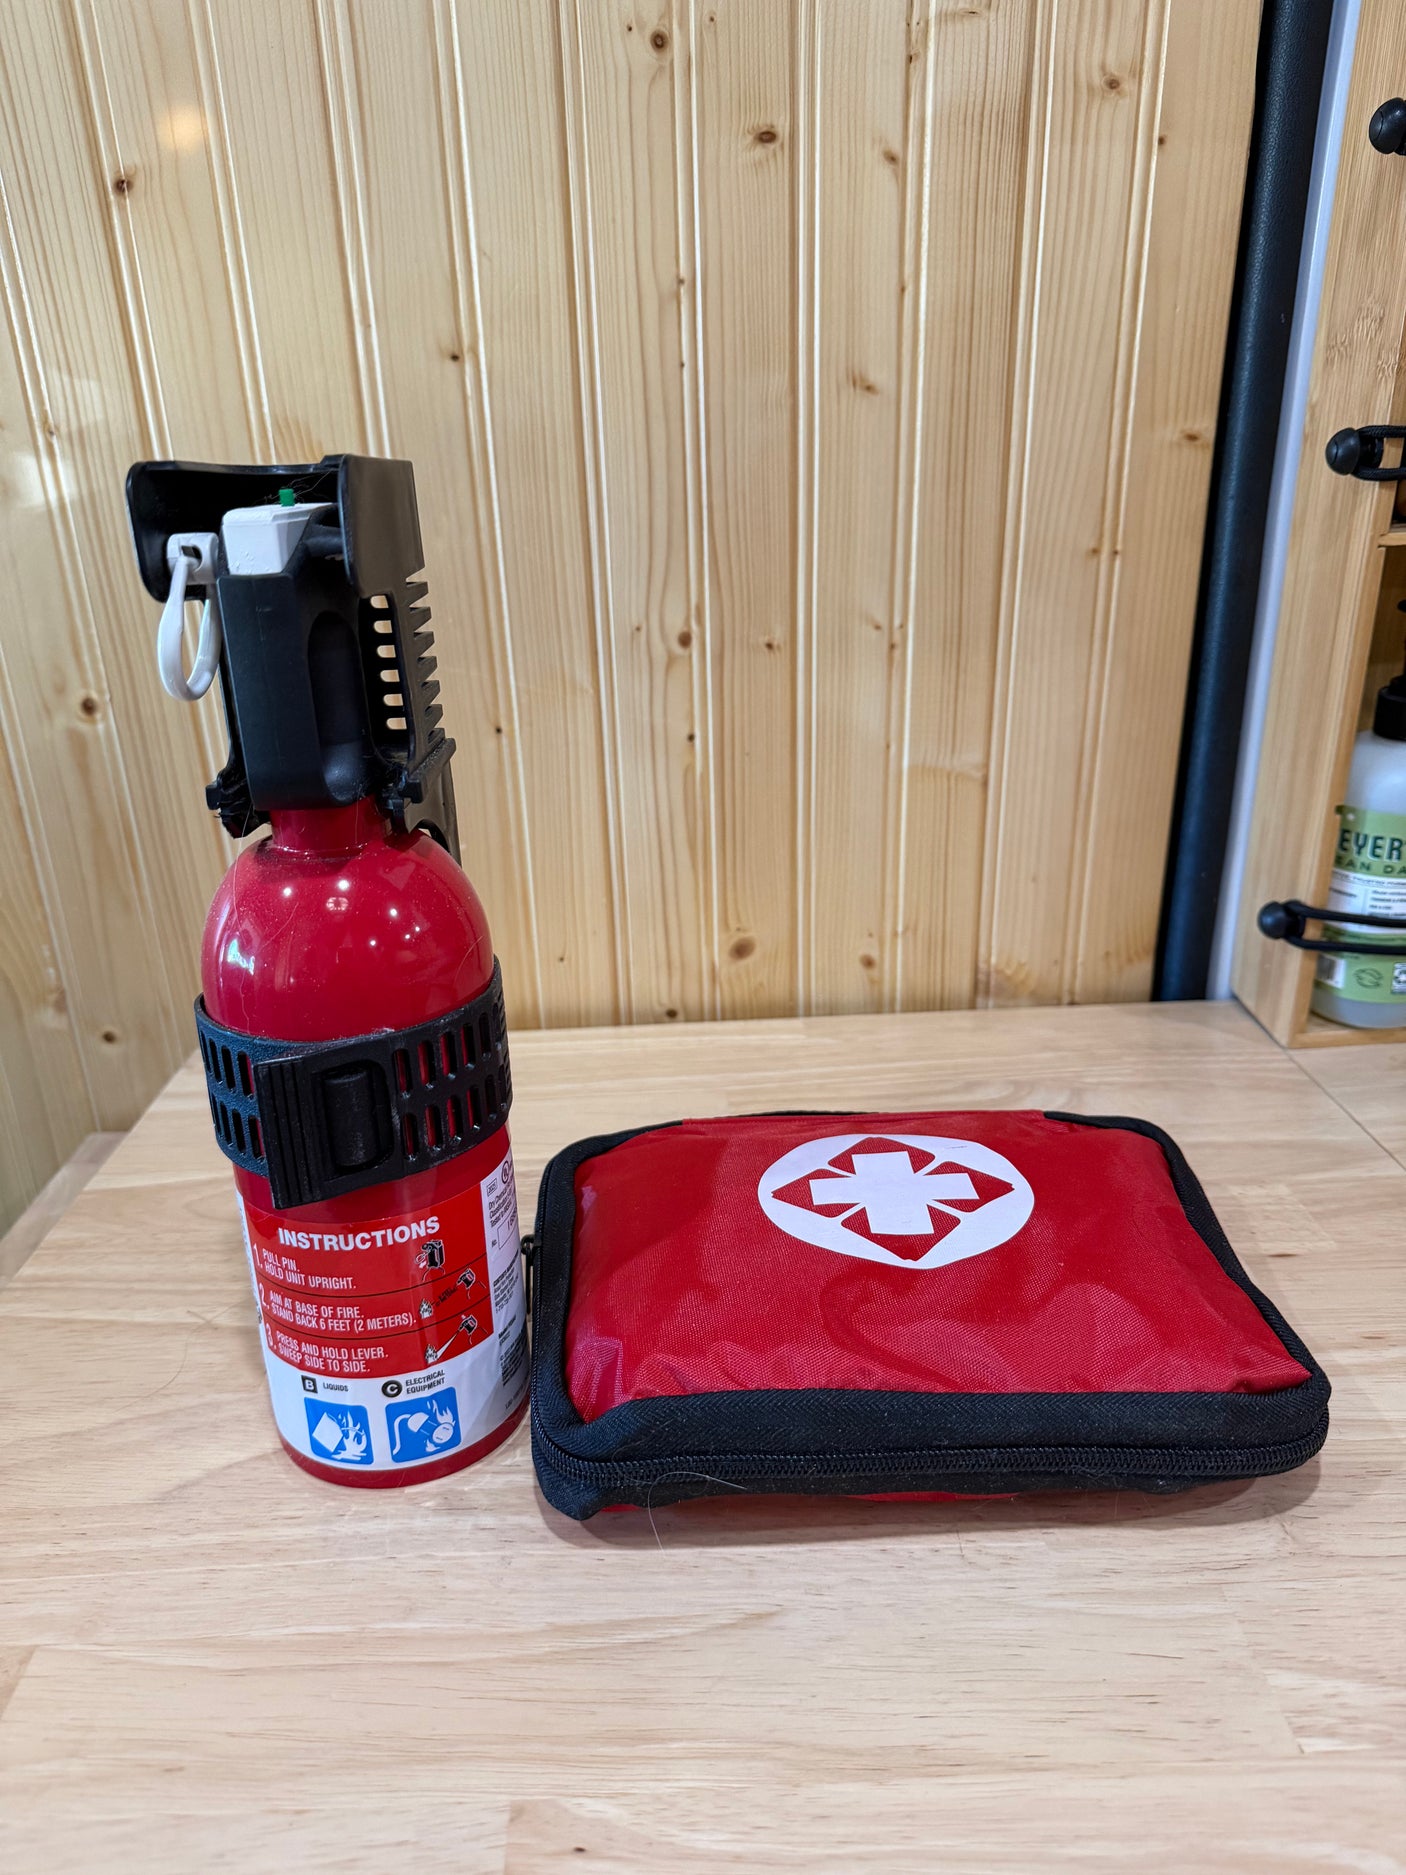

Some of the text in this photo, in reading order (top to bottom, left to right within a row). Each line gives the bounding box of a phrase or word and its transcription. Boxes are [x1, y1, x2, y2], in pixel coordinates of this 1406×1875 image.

[1338, 828, 1406, 861] EYER
[278, 1216, 440, 1251] INSTRUCTIONS
[262, 1248, 281, 1267] PULL
[281, 1256, 300, 1272] PIN.
[265, 1261, 357, 1290] HOLD UNIT UPRIGHT.
[270, 1290, 283, 1306] AIM
[284, 1297, 293, 1310] AT
[295, 1301, 319, 1317] BASE
[321, 1306, 334, 1318] OF
[336, 1306, 364, 1319] FIRE.
[271, 1303, 294, 1322] STAND
[295, 1313, 319, 1329] BACK
[319, 1318, 326, 1330] 6
[328, 1319, 350, 1332] FEET
[354, 1318, 364, 1334] (2
[367, 1312, 417, 1331] METERS).
[276, 1330, 300, 1351] PRESS
[301, 1342, 319, 1357] AND
[321, 1346, 348, 1360] HOLD
[351, 1346, 389, 1360] LEVER.
[278, 1342, 371, 1373] SWEEP SIDE TO SIDE.
[322, 1382, 349, 1392] LIQUIDS
[405, 1369, 445, 1387] ELECTRICAL
[406, 1377, 446, 1395] EQUIPMENT
